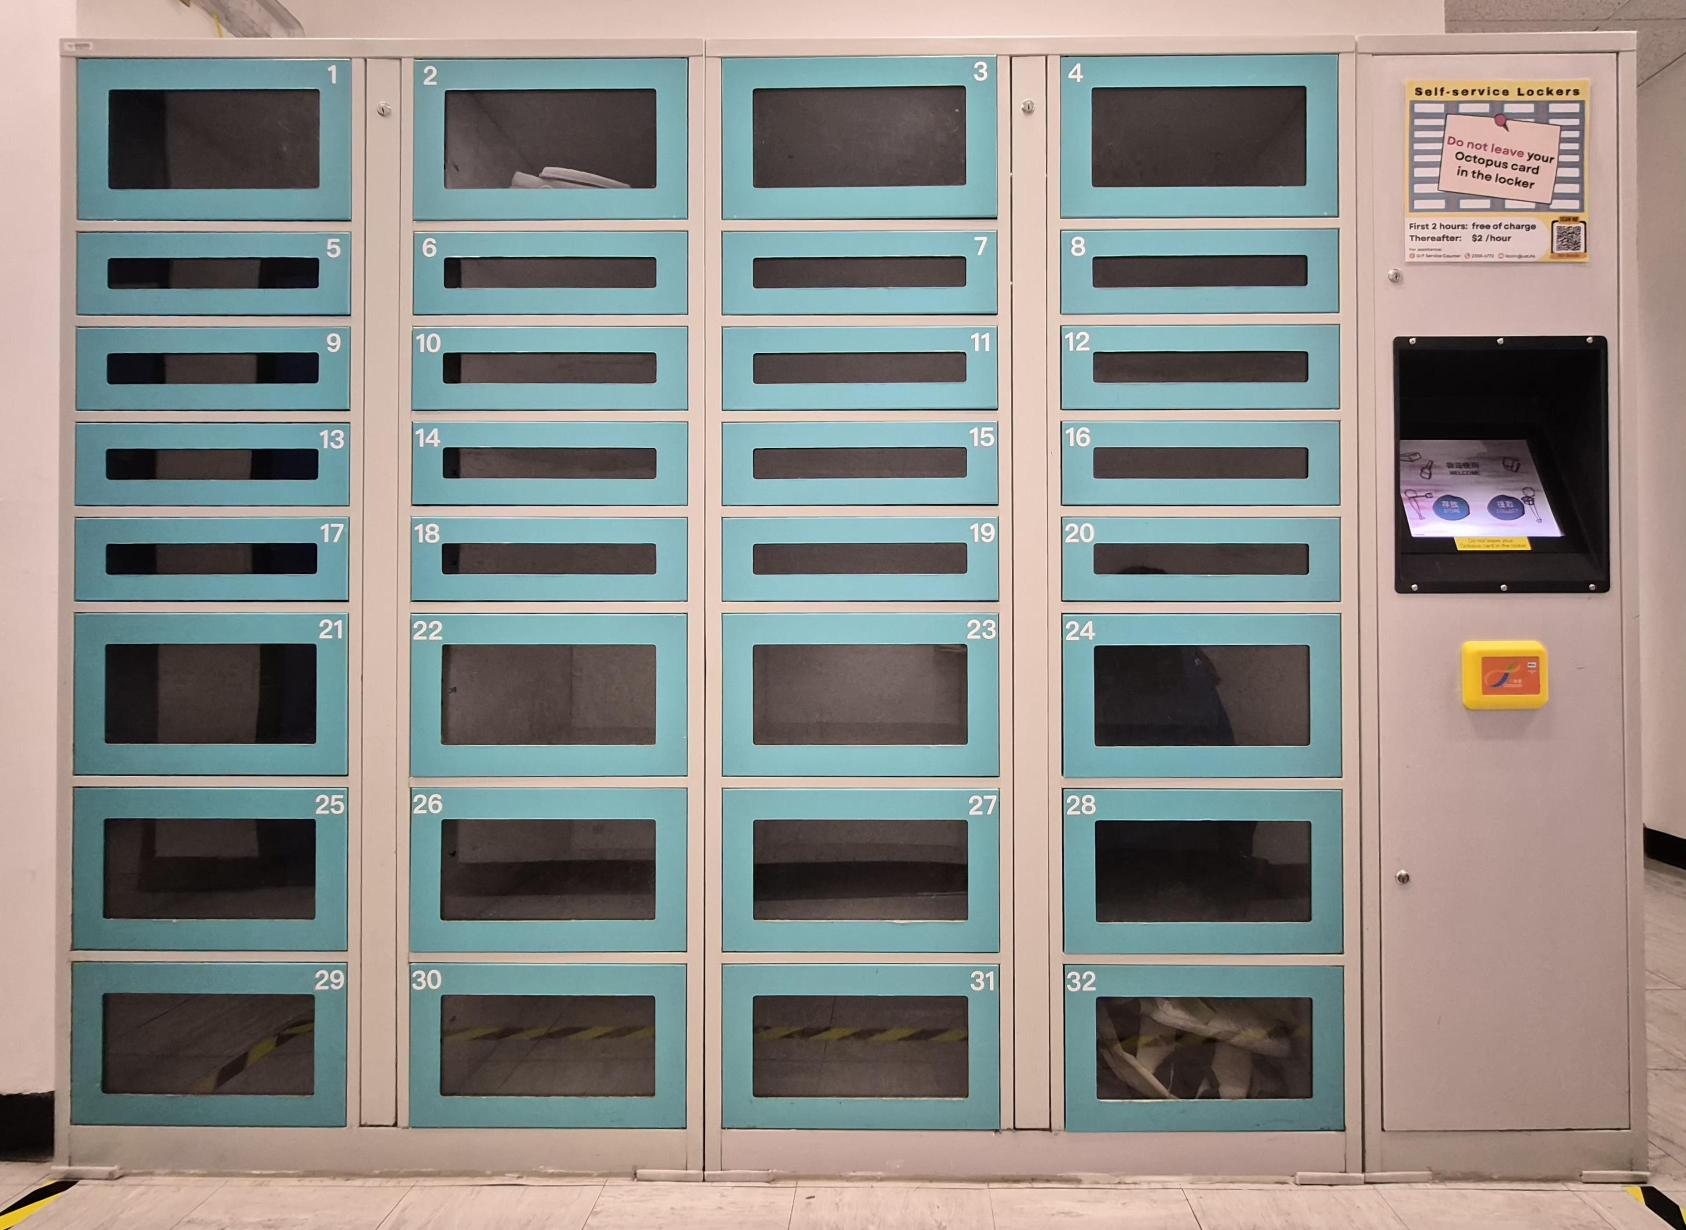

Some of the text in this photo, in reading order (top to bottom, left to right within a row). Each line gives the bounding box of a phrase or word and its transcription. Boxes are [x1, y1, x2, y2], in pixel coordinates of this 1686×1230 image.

[328, 65, 336, 83] 1
[424, 66, 437, 85] 2
[974, 61, 988, 81] 3
[1068, 63, 1084, 82] 4
[1414, 86, 1580, 97] Self-service Lockers
[1446, 135, 1556, 165] Do not leave your
[1454, 151, 1540, 176] Octopus card
[1456, 166, 1536, 190] in the locker
[1409, 222, 1537, 232] First 2 hours: free of charge
[327, 239, 340, 258] 5
[422, 238, 436, 257] 6
[974, 236, 988, 255] 7
[1071, 236, 1086, 256] 8
[1409, 234, 1512, 244] Thereafter: $2 /hour
[327, 333, 341, 352] 9
[416, 333, 441, 352] 10
[971, 333, 990, 352] 11
[1065, 332, 1091, 352] 12
[320, 430, 344, 449] 13
[416, 428, 440, 447] 14
[969, 427, 995, 448] 15
[1065, 427, 1091, 448] 16
[321, 524, 344, 542] 17
[415, 524, 440, 543] 18
[970, 523, 995, 544] 19
[1065, 523, 1094, 544] 20
[320, 619, 342, 639] 21
[413, 621, 442, 640] 22
[967, 619, 997, 639] 23
[1066, 621, 1095, 640] 24
[316, 795, 344, 814] 25
[413, 794, 442, 814] 26
[969, 795, 997, 815] 27
[1067, 795, 1096, 815] 28
[315, 970, 344, 990] 29
[412, 970, 441, 990] 30
[971, 971, 994, 991] 31
[1067, 971, 1096, 991] 32
